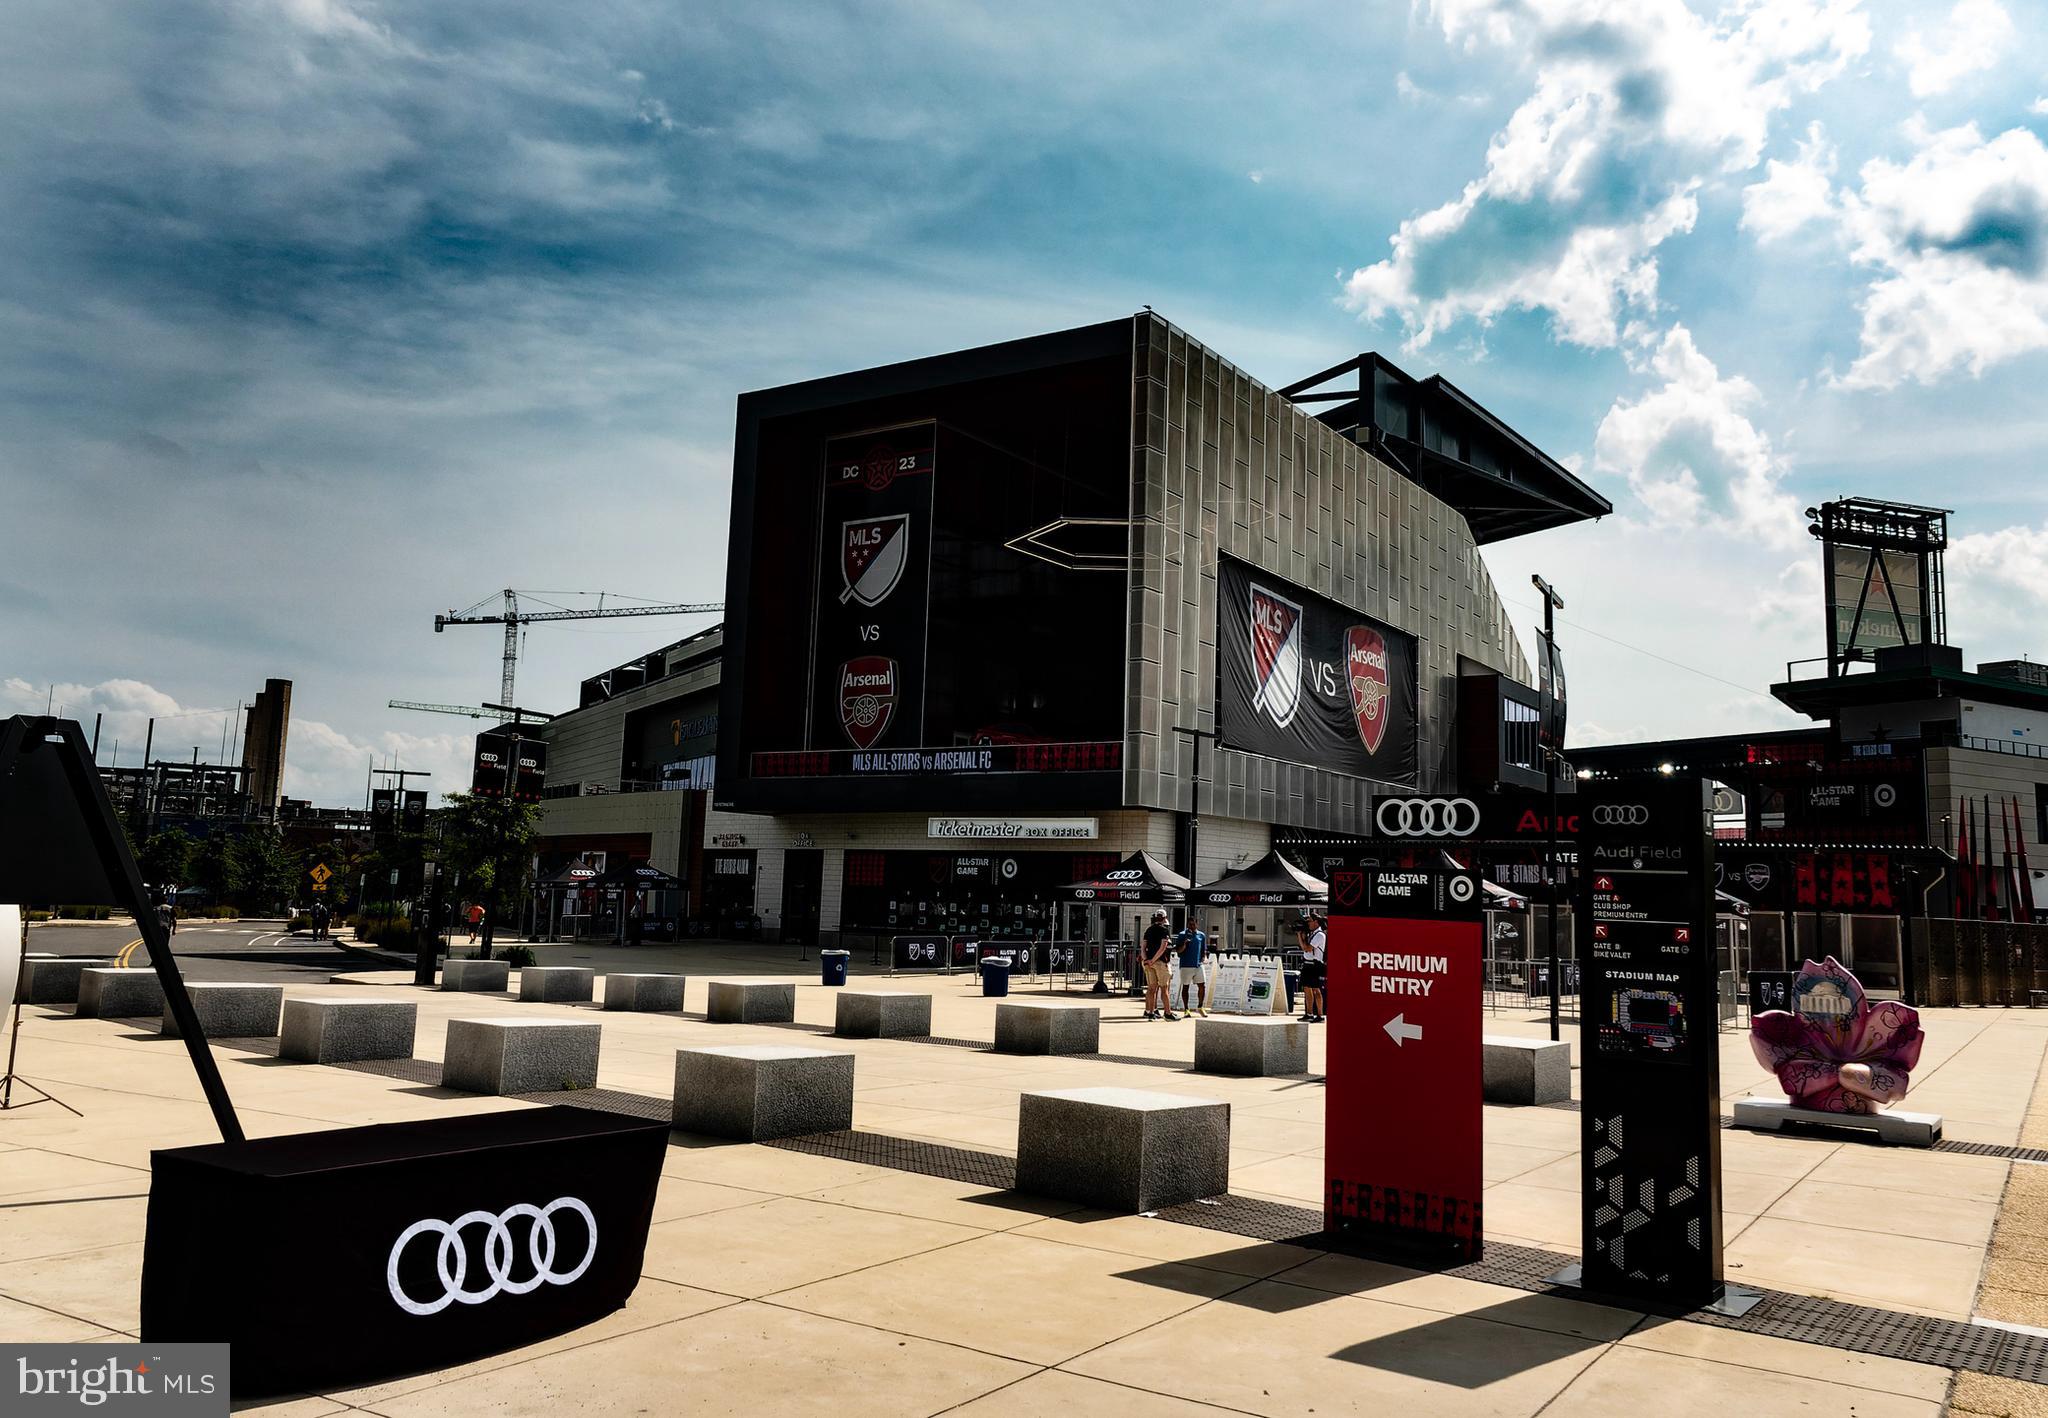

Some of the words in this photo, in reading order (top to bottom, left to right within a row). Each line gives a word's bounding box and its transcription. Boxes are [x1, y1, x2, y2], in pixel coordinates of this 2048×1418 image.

[843, 465, 859, 478] DC
[899, 456, 916, 470] 23
[849, 527, 882, 547] MLS
[1255, 600, 1282, 634] MLS
[860, 625, 880, 641] VS
[1350, 643, 1385, 671] Arsenal
[844, 670, 890, 687] Arsenal
[1309, 658, 1336, 696] VS
[852, 753, 870, 771] MLS
[872, 752, 920, 771] ALL-STARS
[933, 751, 977, 770] ARSENAL
[979, 750, 992, 769] FC
[936, 820, 1022, 837] ticketmaster
[1025, 828, 1046, 837] BOX
[1051, 828, 1089, 837] OFFICE
[1594, 845, 1635, 858] Audi
[1640, 845, 1681, 859] Field
[957, 858, 989, 867] ALL-STAR
[957, 867, 978, 875] GAME
[1377, 872, 1428, 885] ALL-STAR
[1495, 864, 1511, 883] THE
[1512, 864, 1541, 884] STARS
[1120, 891, 1140, 899] Field
[1259, 893, 1283, 902] Field
[1377, 885, 1411, 896] GAME
[1593, 910, 1625, 918] PREMIUM
[1593, 942, 1611, 950] GATE
[1593, 950, 1610, 958] BIKE
[1610, 951, 1631, 959] VALET
[1357, 952, 1447, 974] PREMIUM
[1605, 970, 1653, 980] STADIUM
[1656, 973, 1680, 982] MAP
[1370, 975, 1434, 996] ENTRY
